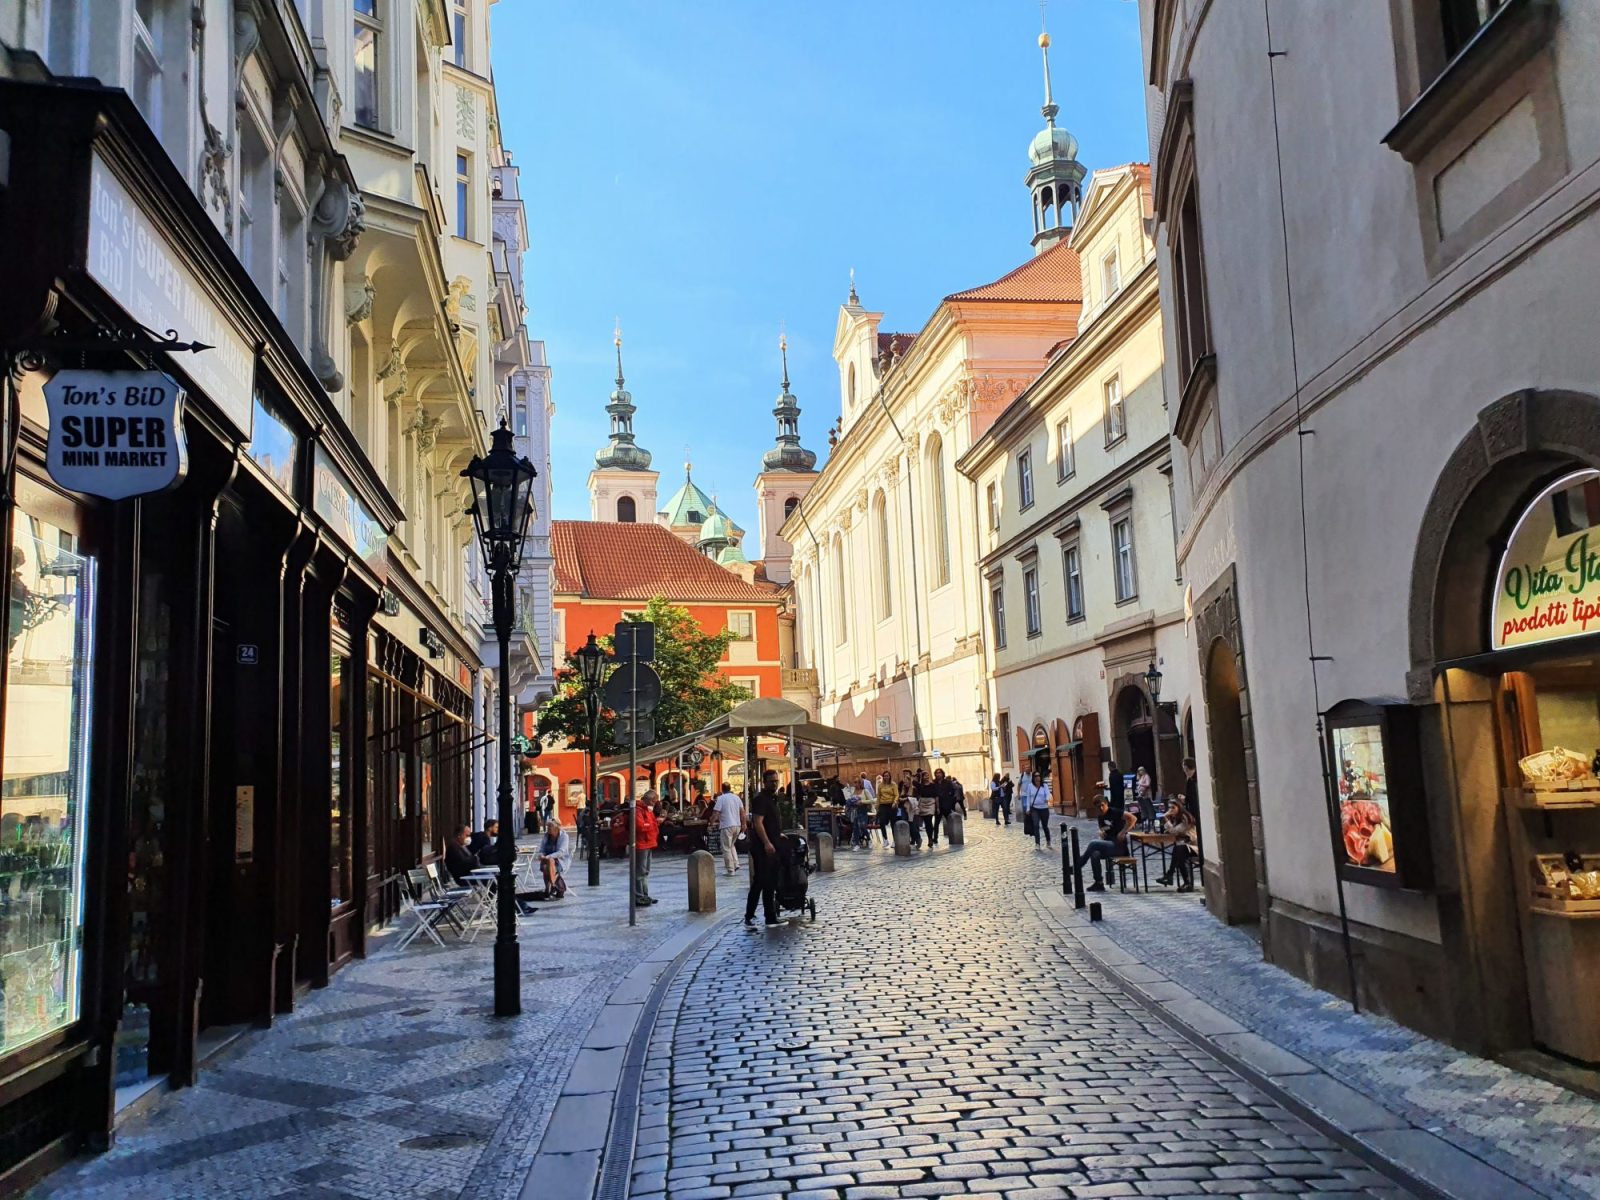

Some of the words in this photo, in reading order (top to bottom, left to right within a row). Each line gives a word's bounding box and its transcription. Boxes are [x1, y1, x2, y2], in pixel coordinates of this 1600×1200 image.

[100, 229, 124, 292] BiD
[136, 225, 182, 311] SUPER
[61, 385, 116, 406] Ton's
[124, 386, 166, 406] BiD
[61, 415, 166, 448] SUPER
[62, 451, 99, 467] MINI
[104, 451, 167, 467] MARKET
[1504, 563, 1563, 610] Vita
[1501, 602, 1568, 645] prodotti
[241, 647, 254, 657] 24
